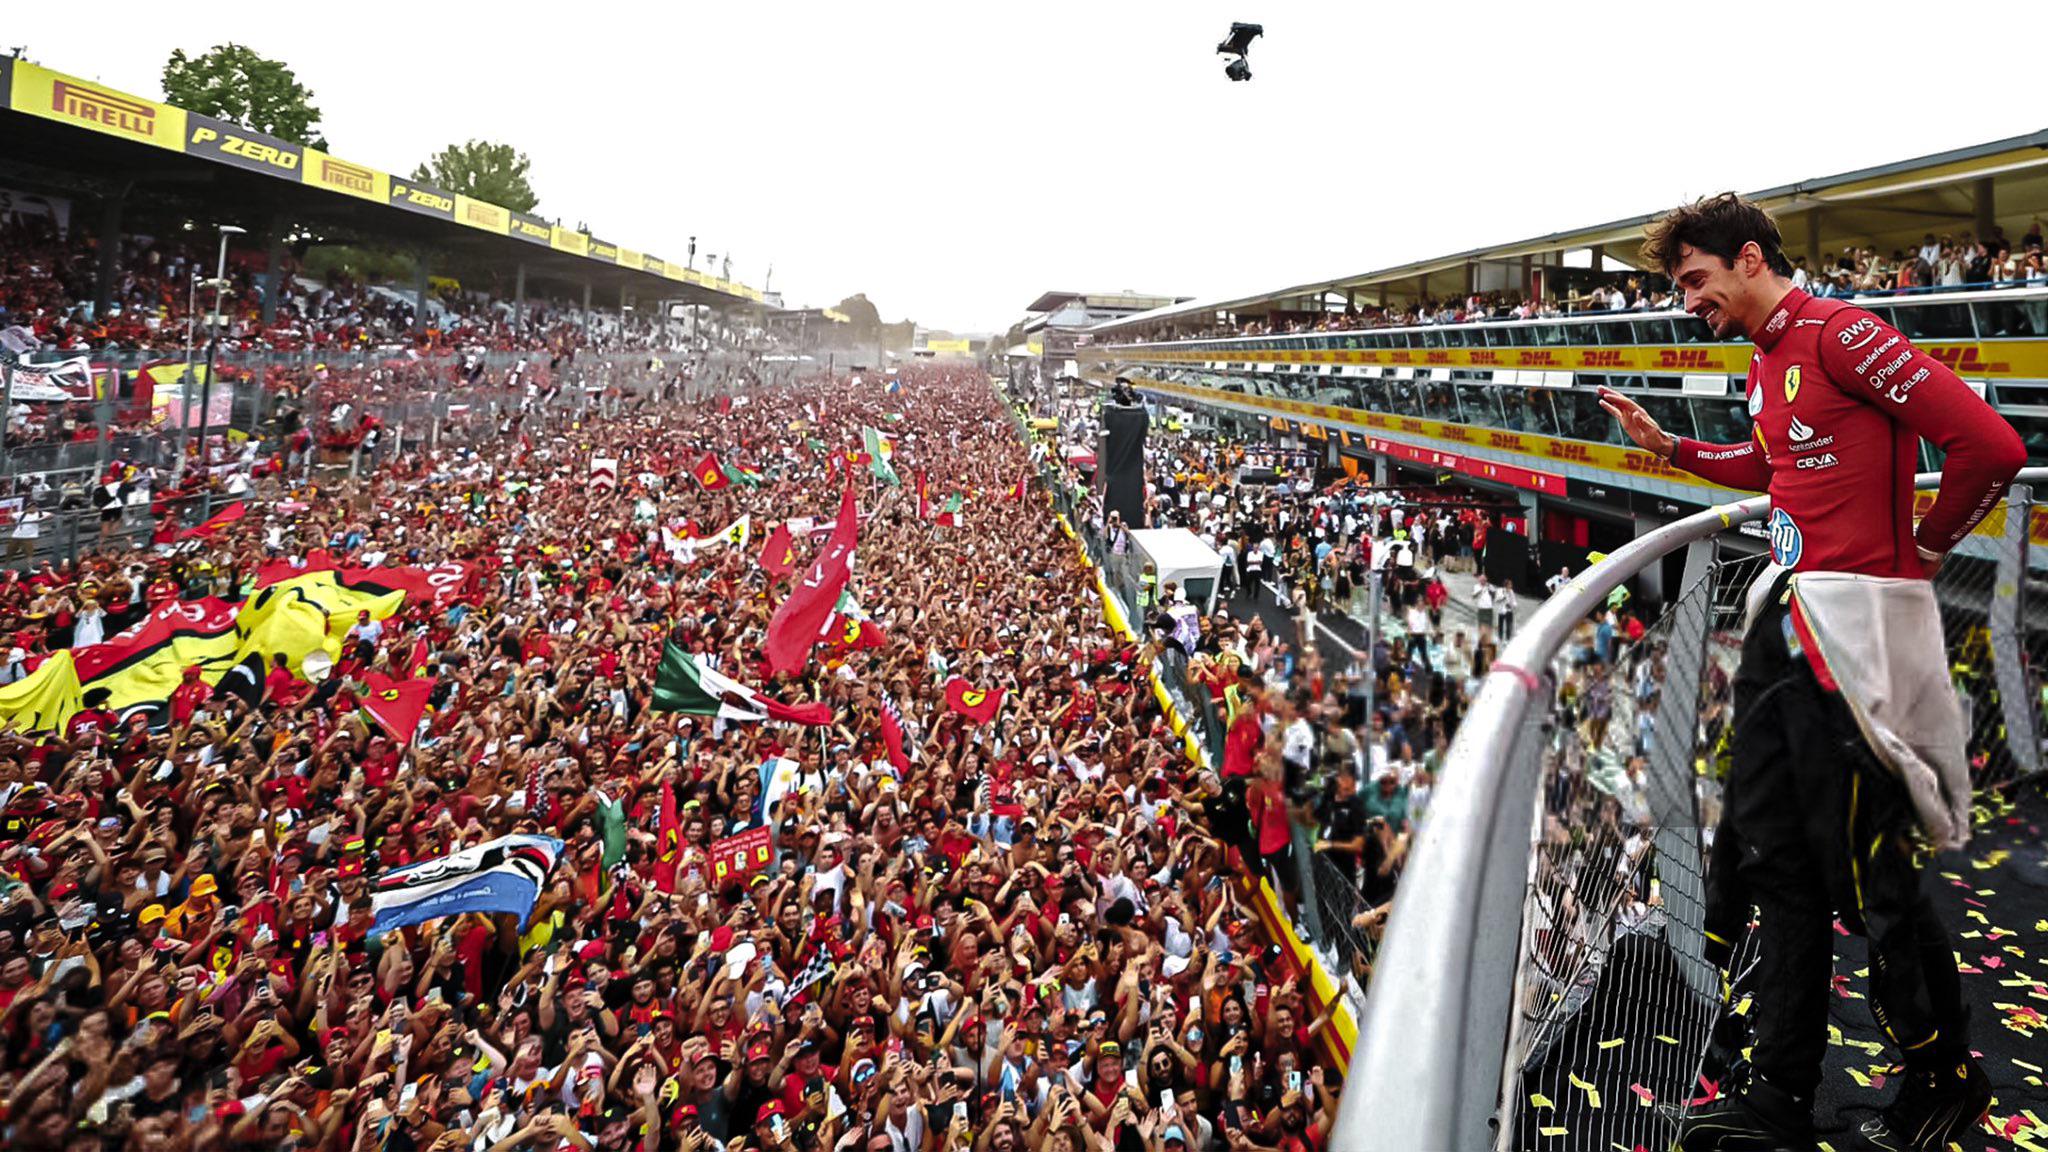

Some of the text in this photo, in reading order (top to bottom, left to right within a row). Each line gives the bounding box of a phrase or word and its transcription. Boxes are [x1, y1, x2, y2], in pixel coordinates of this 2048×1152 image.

[52, 79, 155, 136] PIRELLI
[191, 126, 299, 170] P ZERO
[322, 159, 374, 194] PIRELLI
[392, 184, 453, 213] P ZERO
[1838, 317, 1875, 345] aws
[1470, 351, 1498, 365] DHL
[1519, 351, 1557, 366] DHL
[1582, 350, 1627, 367] DHL
[1659, 350, 1714, 369] DHL
[1854, 335, 1901, 375] Bitdefender
[1877, 349, 1913, 381] Palantir
[1918, 347, 1989, 372] HL
[1490, 432, 1526, 450] DHL
[1550, 441, 1593, 463] DHL
